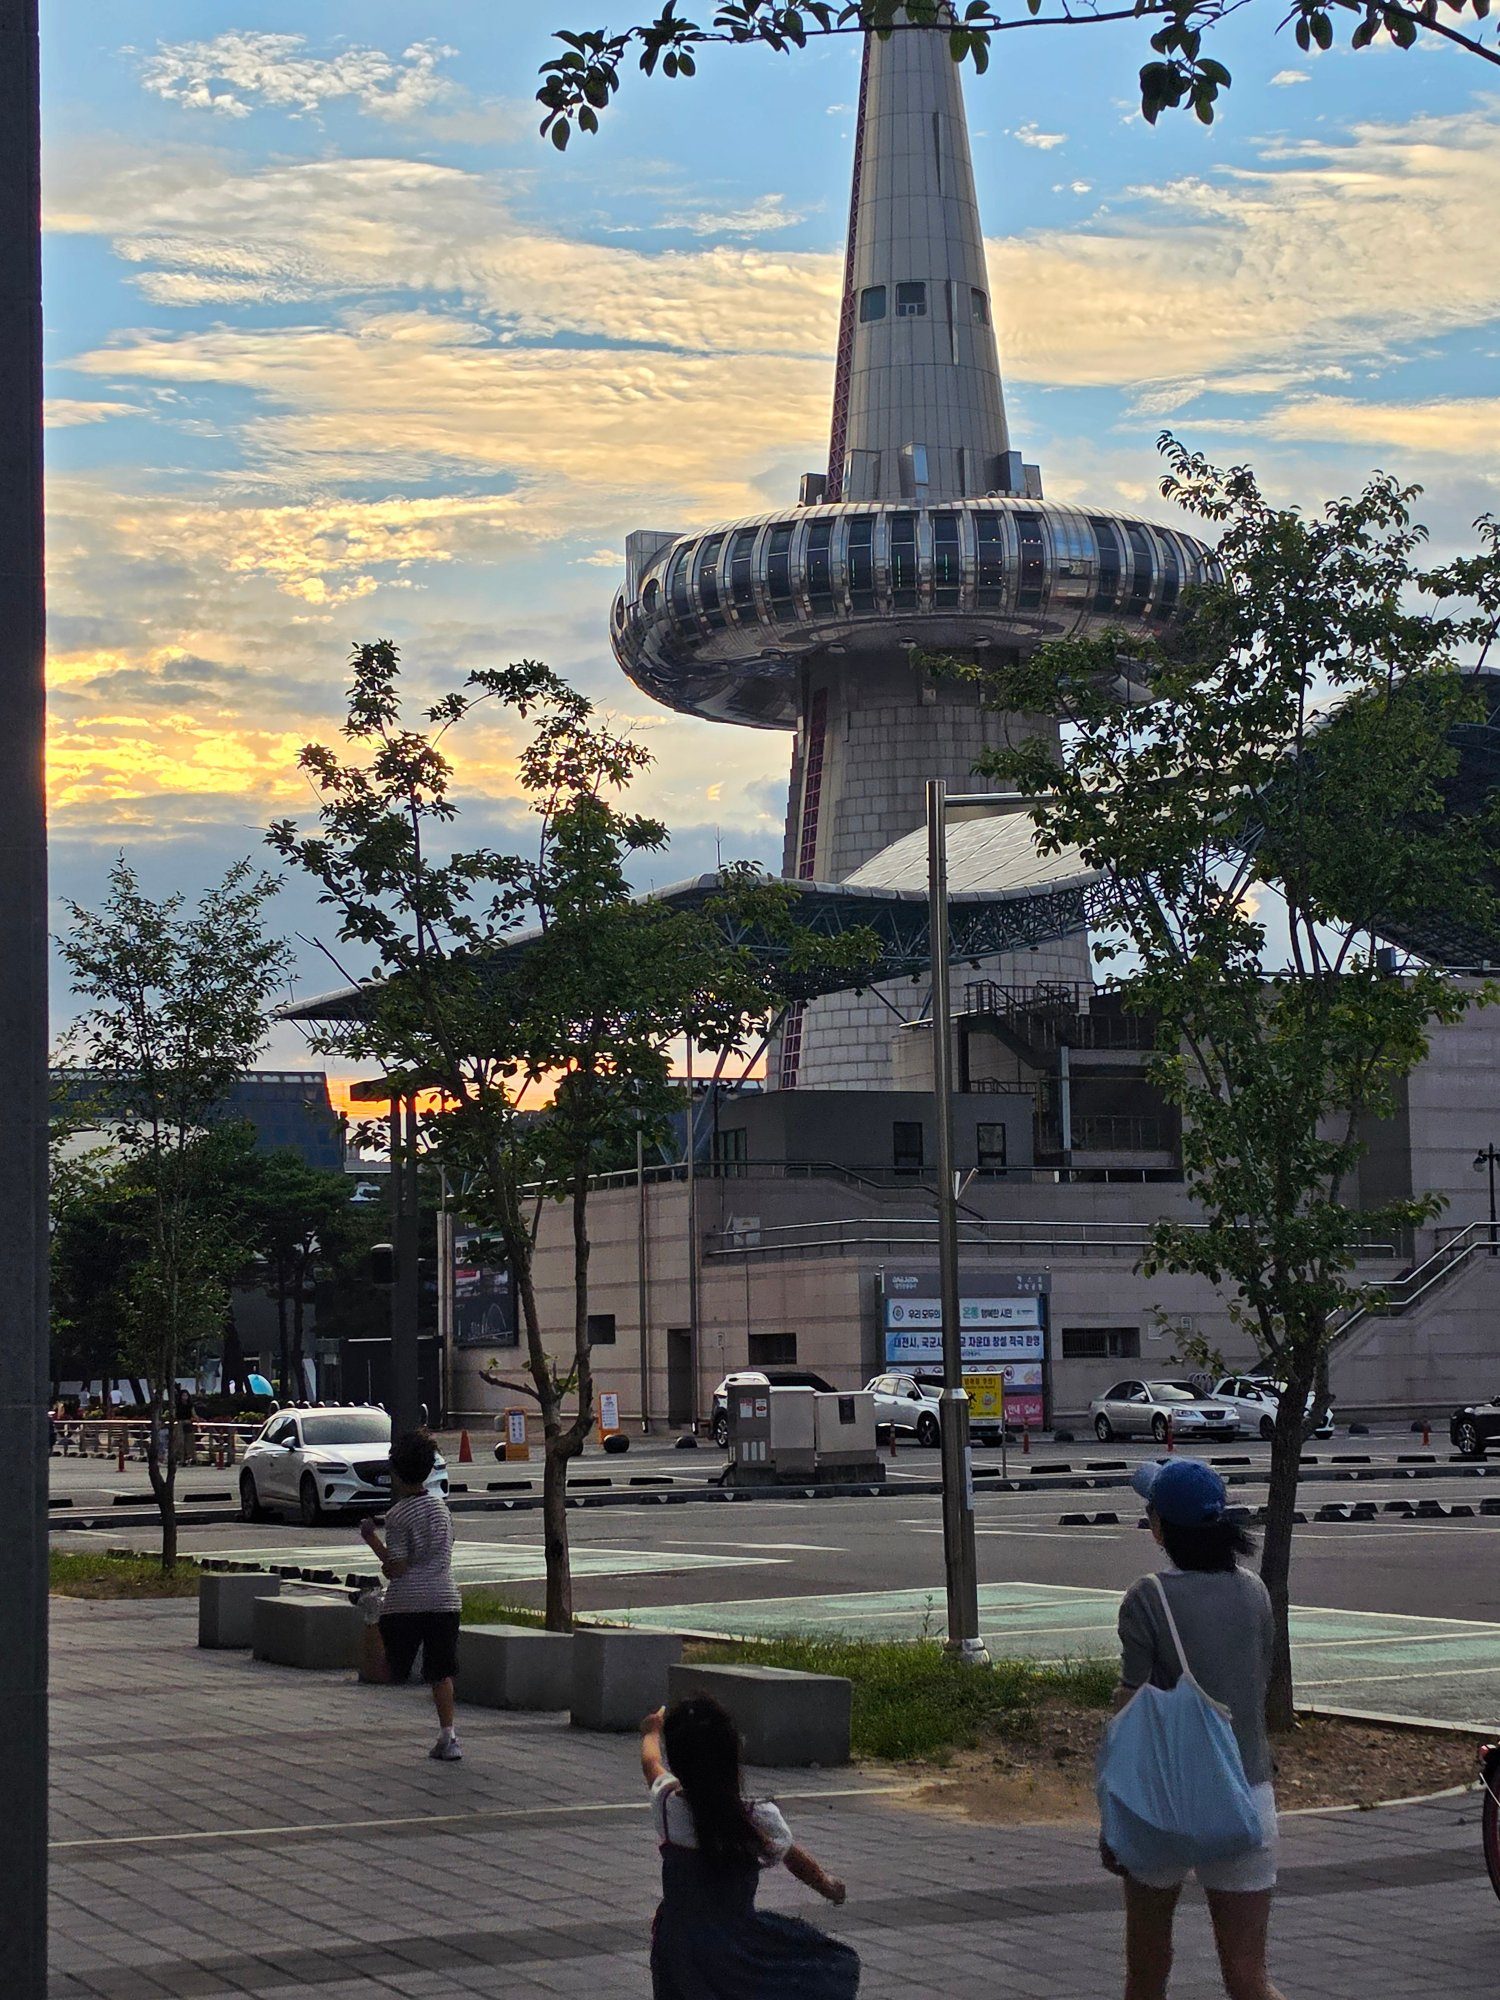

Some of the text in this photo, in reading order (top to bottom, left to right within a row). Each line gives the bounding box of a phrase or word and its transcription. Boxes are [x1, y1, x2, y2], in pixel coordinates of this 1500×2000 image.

[908, 1309, 920, 1319] 우리
[922, 1309, 940, 1319] 모두의
[981, 1308, 999, 1319] 행복한
[1000, 1308, 1012, 1318] 시민
[892, 1336, 919, 1348] 대전시,
[968, 1336, 990, 1348] 자운대
[993, 1335, 1007, 1347] 창설
[1009, 1335, 1024, 1347] 적극
[1026, 1335, 1040, 1347] 환영
